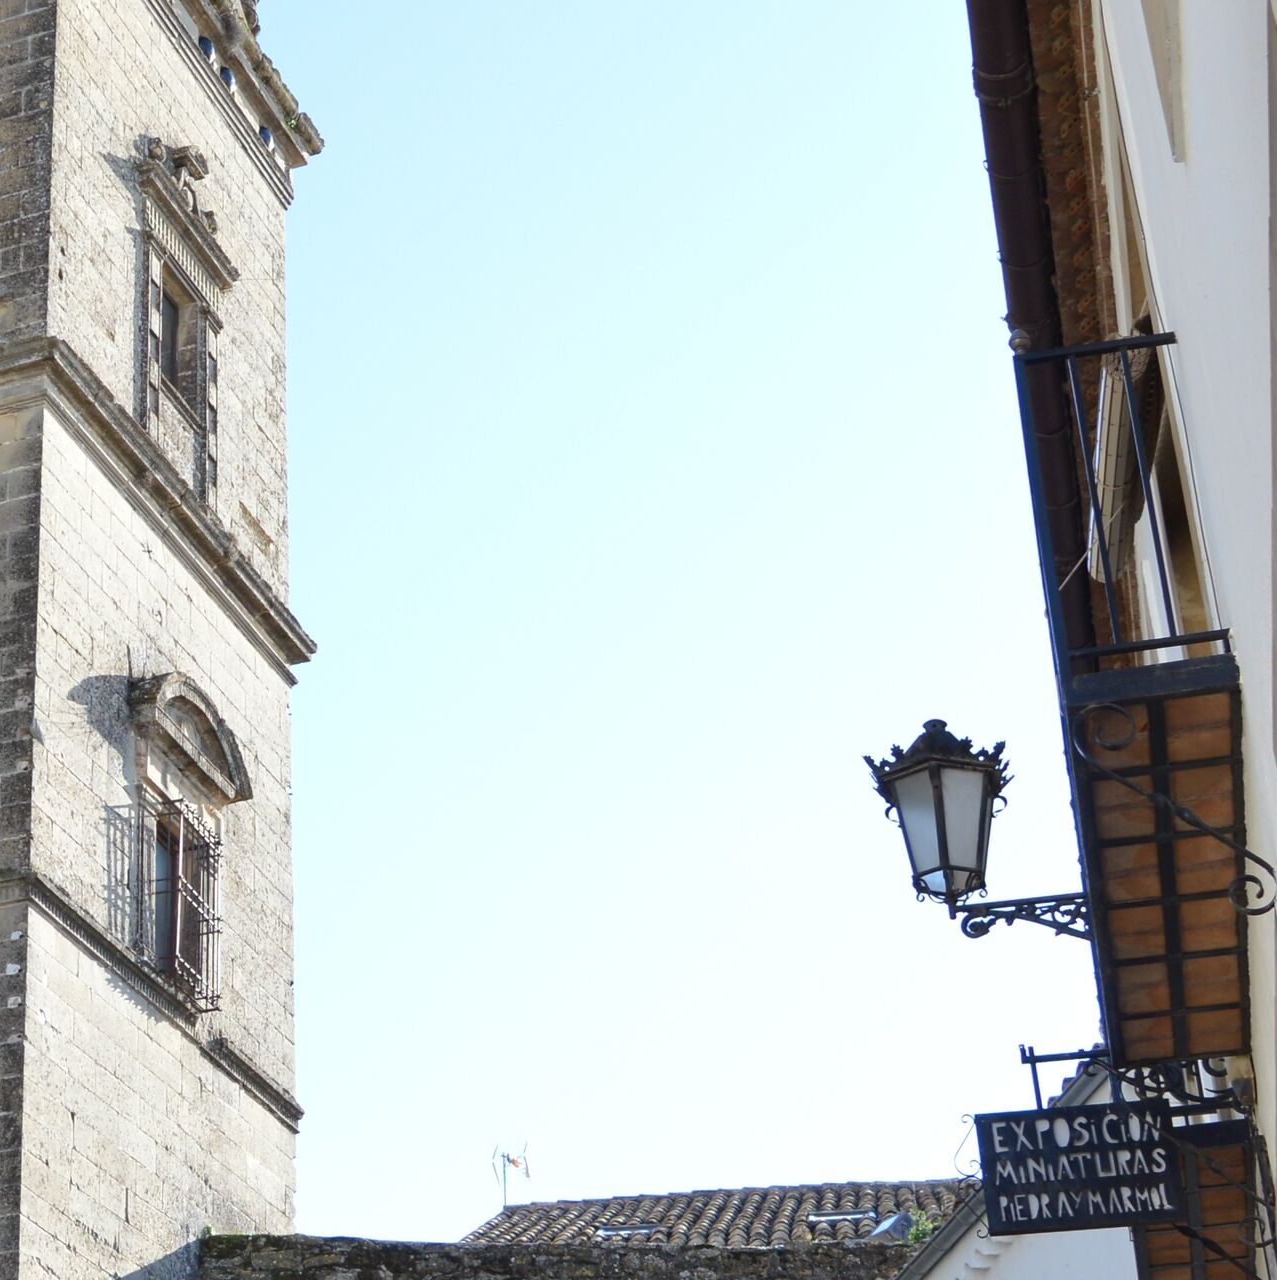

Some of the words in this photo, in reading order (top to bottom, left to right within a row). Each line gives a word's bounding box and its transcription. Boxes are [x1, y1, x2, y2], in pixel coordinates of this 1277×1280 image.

[996, 1148, 1167, 1186] MINIATURAS
[999, 1192, 1074, 1222] PIEDRA
[1087, 1183, 1174, 1216] MARMOL
